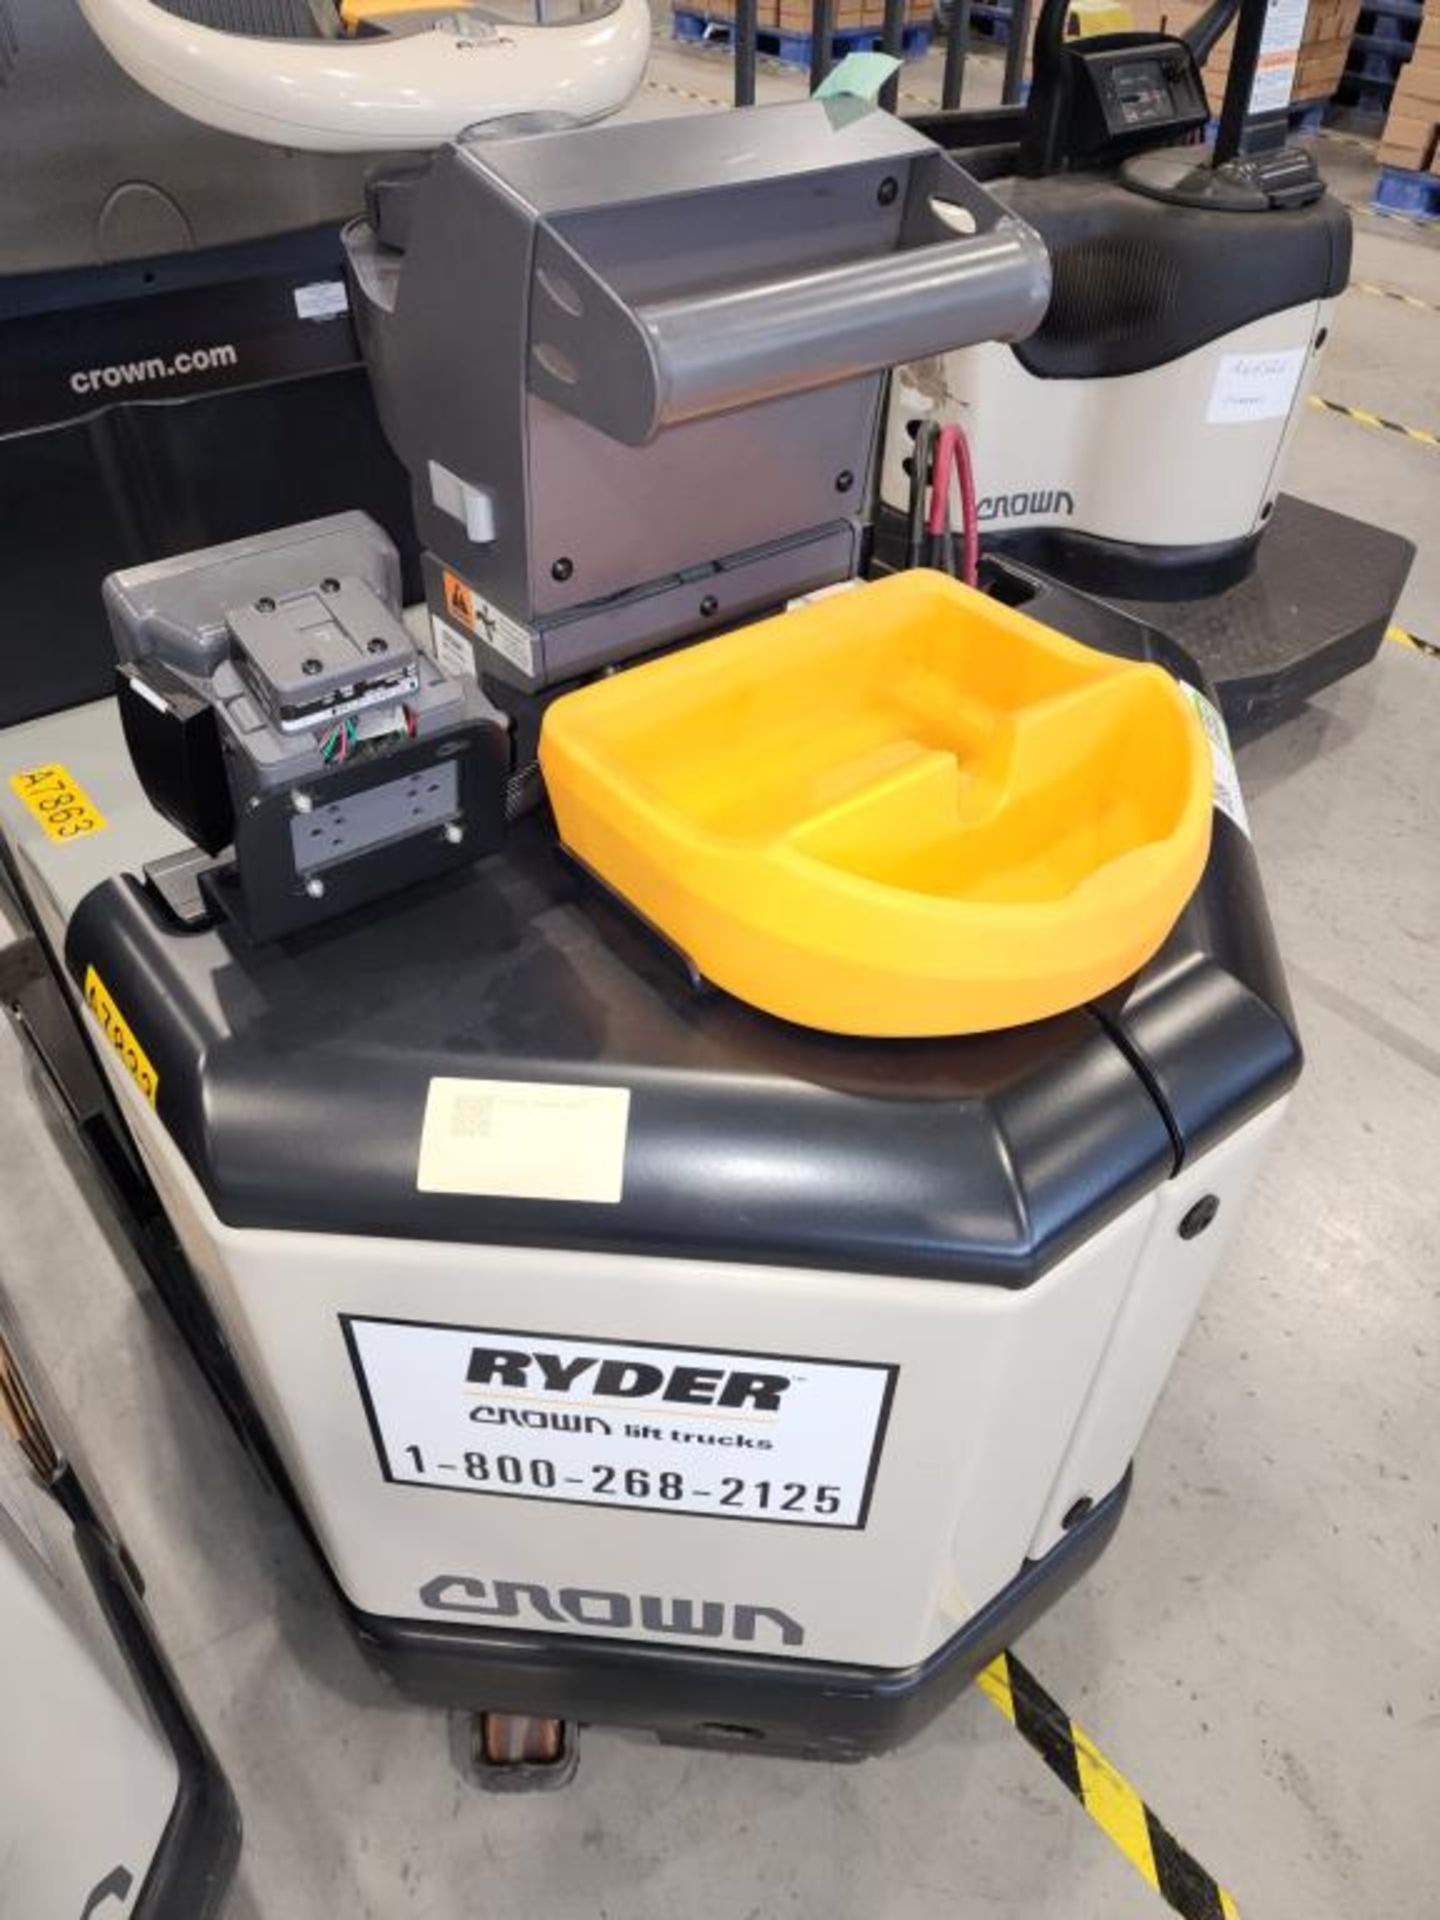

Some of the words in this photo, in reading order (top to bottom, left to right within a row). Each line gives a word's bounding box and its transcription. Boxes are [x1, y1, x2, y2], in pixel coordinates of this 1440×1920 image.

[69, 344, 238, 393] crown.com
[19, 771, 94, 836] A7863
[465, 1347, 791, 1411] RYDER
[624, 1423, 663, 1441] lift
[671, 1428, 775, 1451] trucks
[405, 1443, 841, 1515] 1-800-268-2125
[419, 1574, 806, 1646] CROWN
